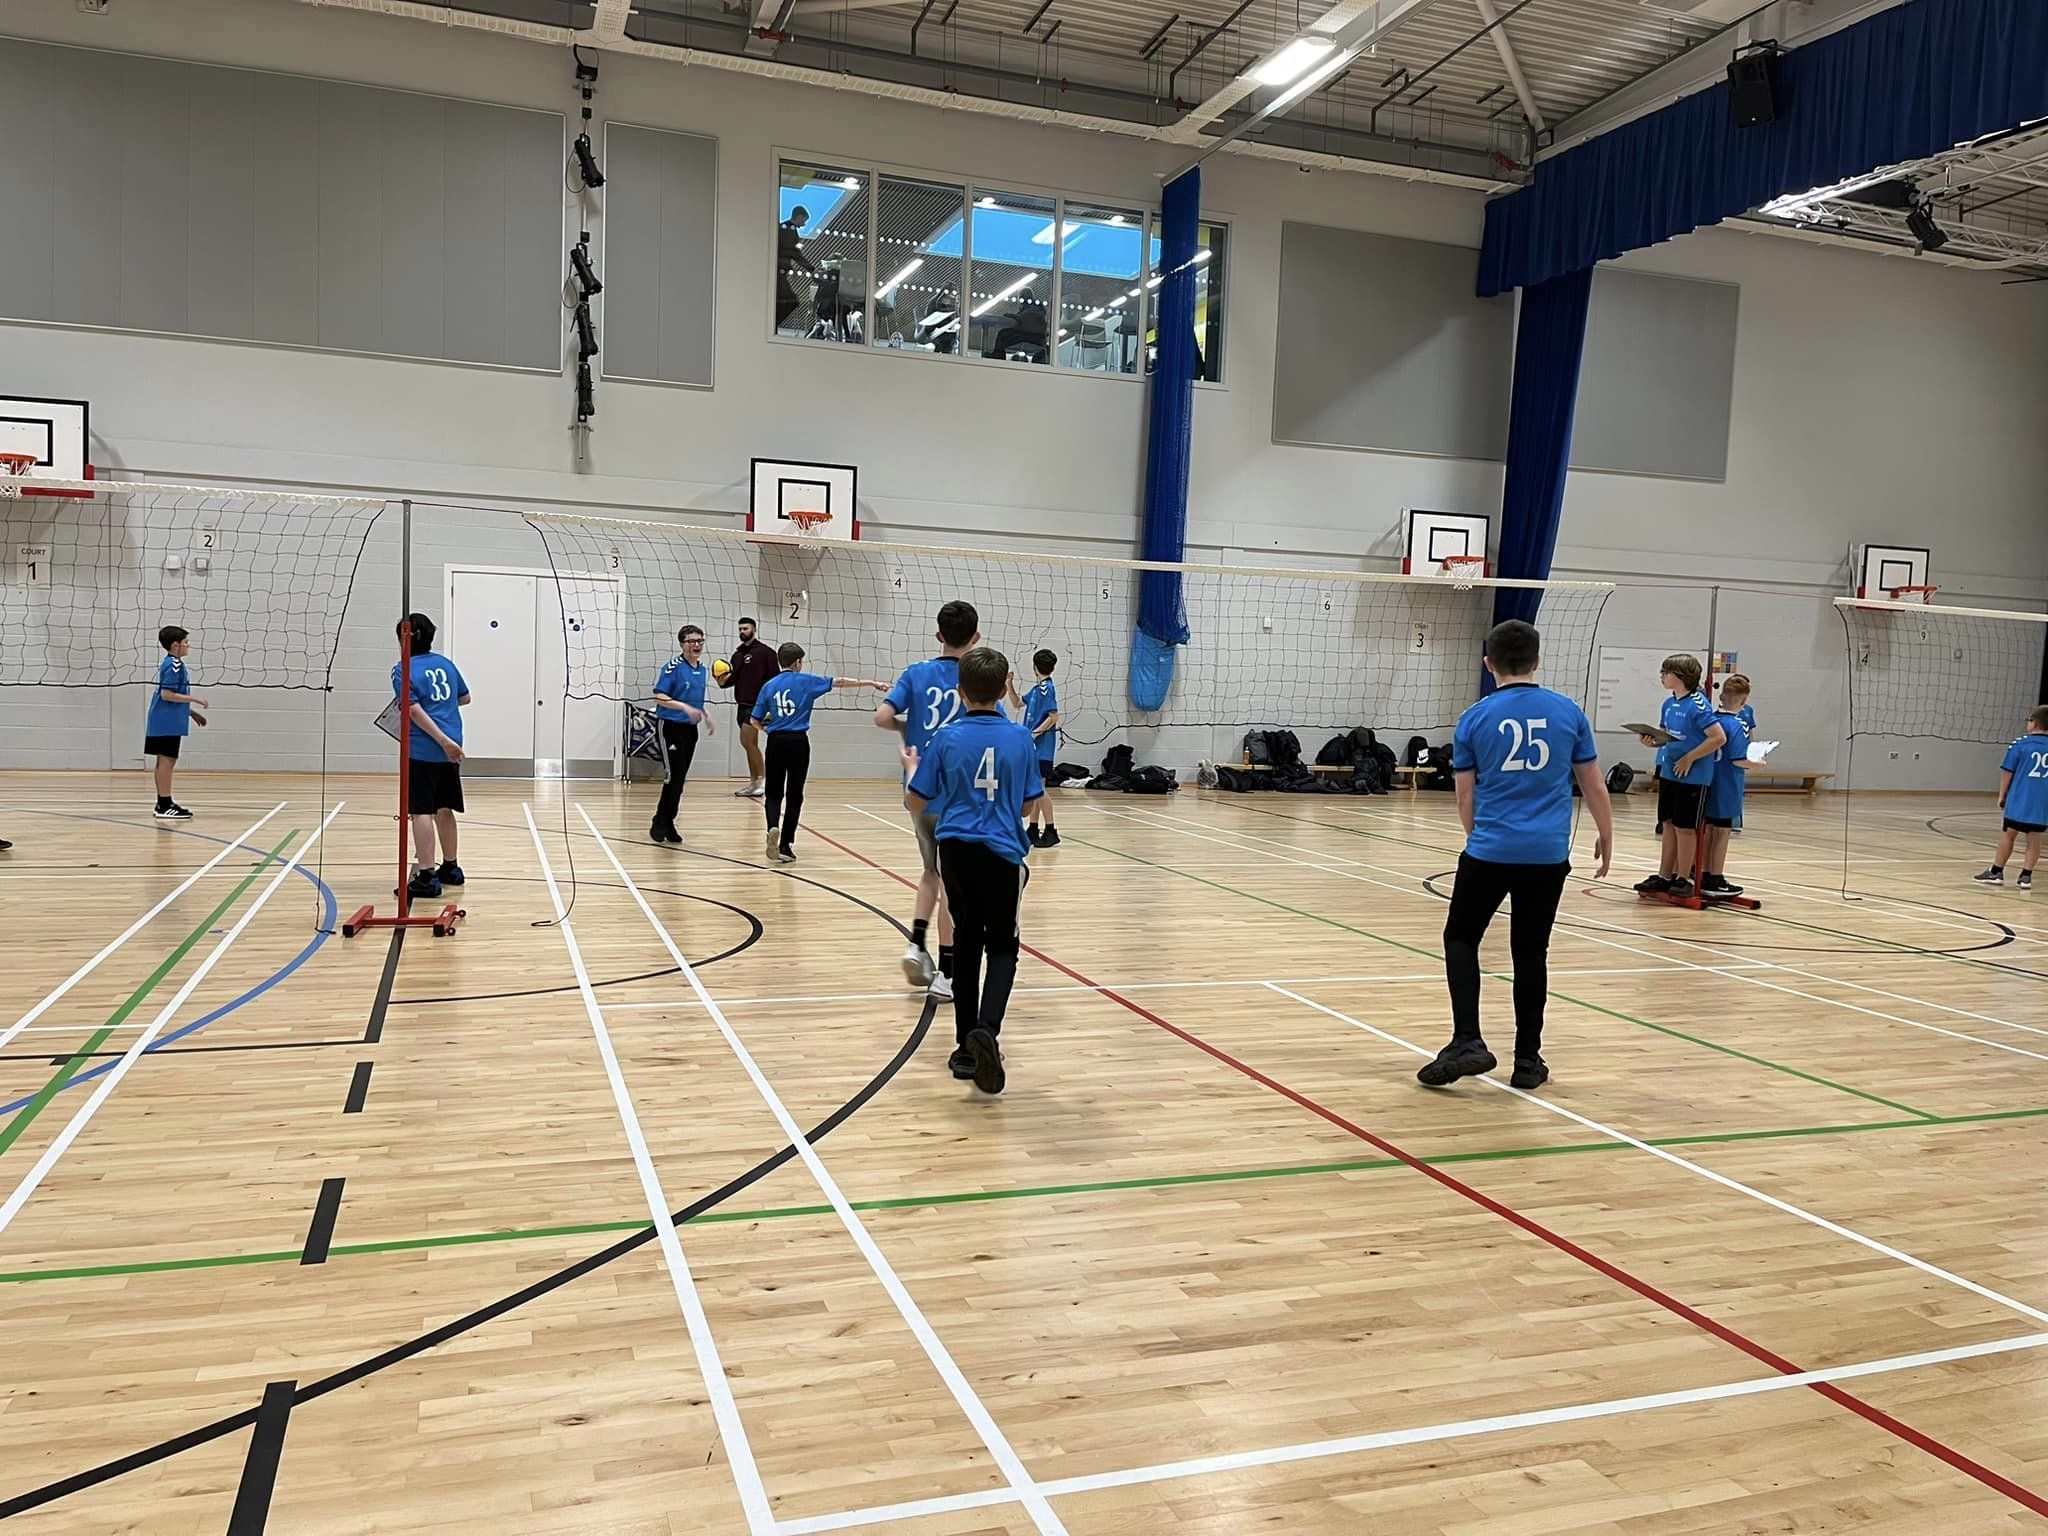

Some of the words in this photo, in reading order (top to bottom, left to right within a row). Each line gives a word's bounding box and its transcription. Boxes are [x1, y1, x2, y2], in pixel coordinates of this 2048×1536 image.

[204, 534, 213, 548] 2
[21, 548, 46, 556] COURT
[28, 561, 36, 580] 1
[612, 556, 619, 569] 3
[894, 577, 902, 589] 4
[1102, 588, 1109, 600] 5
[790, 602, 800, 620] 2
[1324, 599, 1331, 611] 6
[1416, 632, 1424, 648] 3
[1921, 631, 1927, 641] 9
[1861, 653, 1869, 667] 4
[425, 668, 451, 701] 33
[773, 688, 796, 717] 16
[923, 686, 961, 731] 32
[1498, 718, 1550, 772] 25
[2028, 751, 2048, 778] 29
[974, 746, 999, 802] 4
